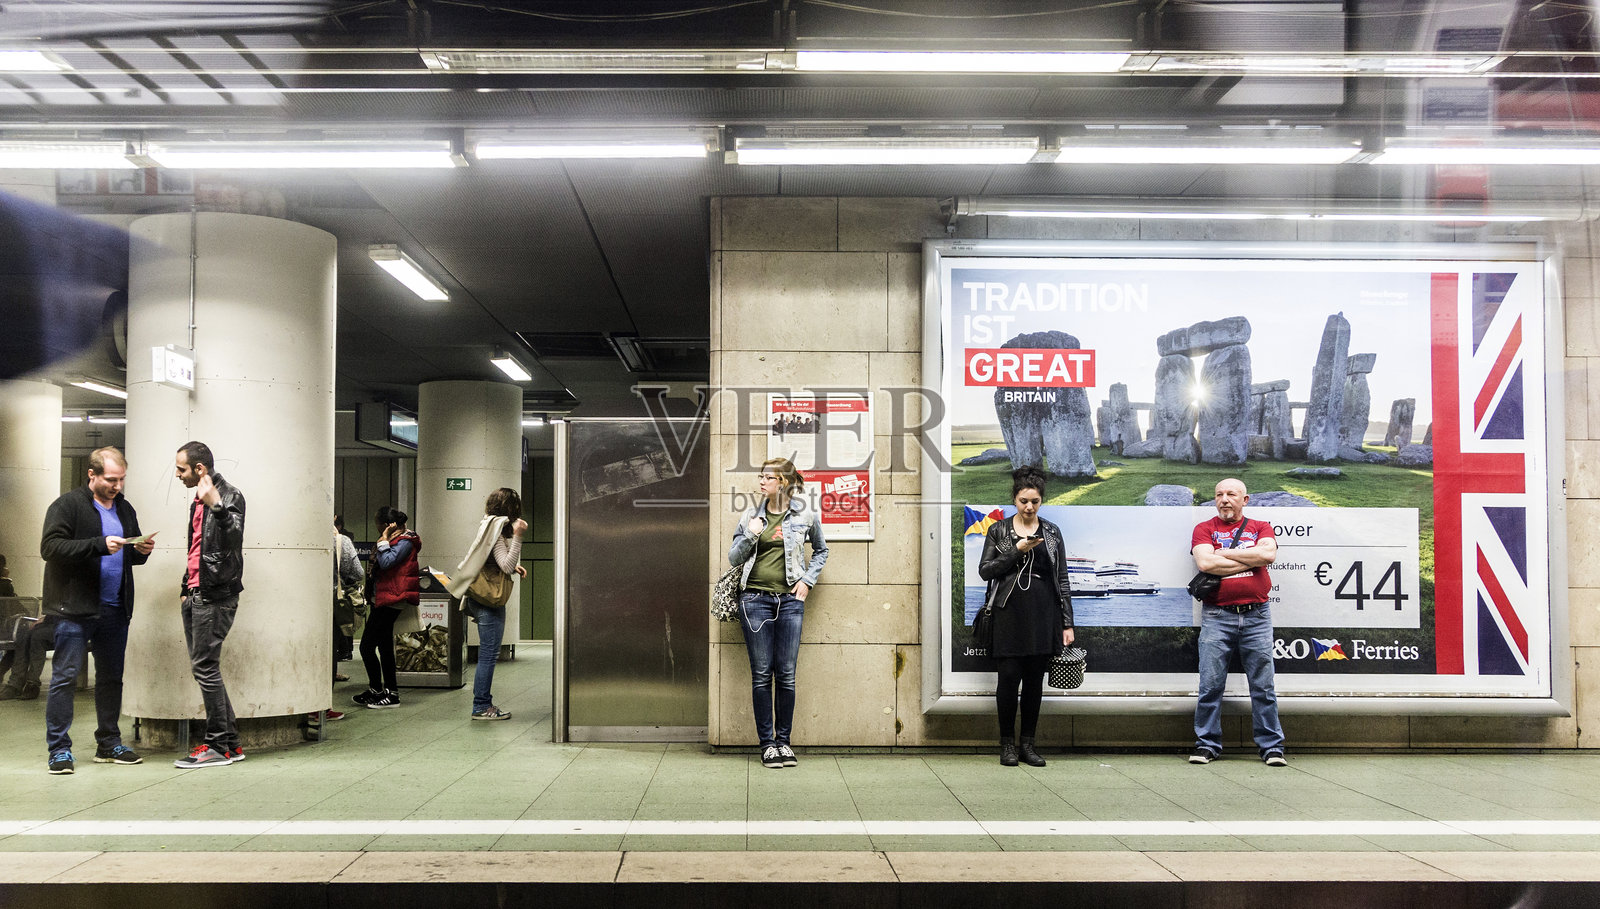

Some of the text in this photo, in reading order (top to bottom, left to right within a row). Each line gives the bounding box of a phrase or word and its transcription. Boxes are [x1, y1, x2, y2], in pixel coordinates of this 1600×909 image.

[962, 281, 1148, 313] TRADITION
[963, 314, 1015, 344] IST
[969, 352, 1091, 383] GREAT
[1004, 391, 1056, 403] BRITAIN
[1268, 521, 1313, 537] over
[963, 646, 987, 656] Jetzt
[1351, 639, 1420, 660] Ferries
